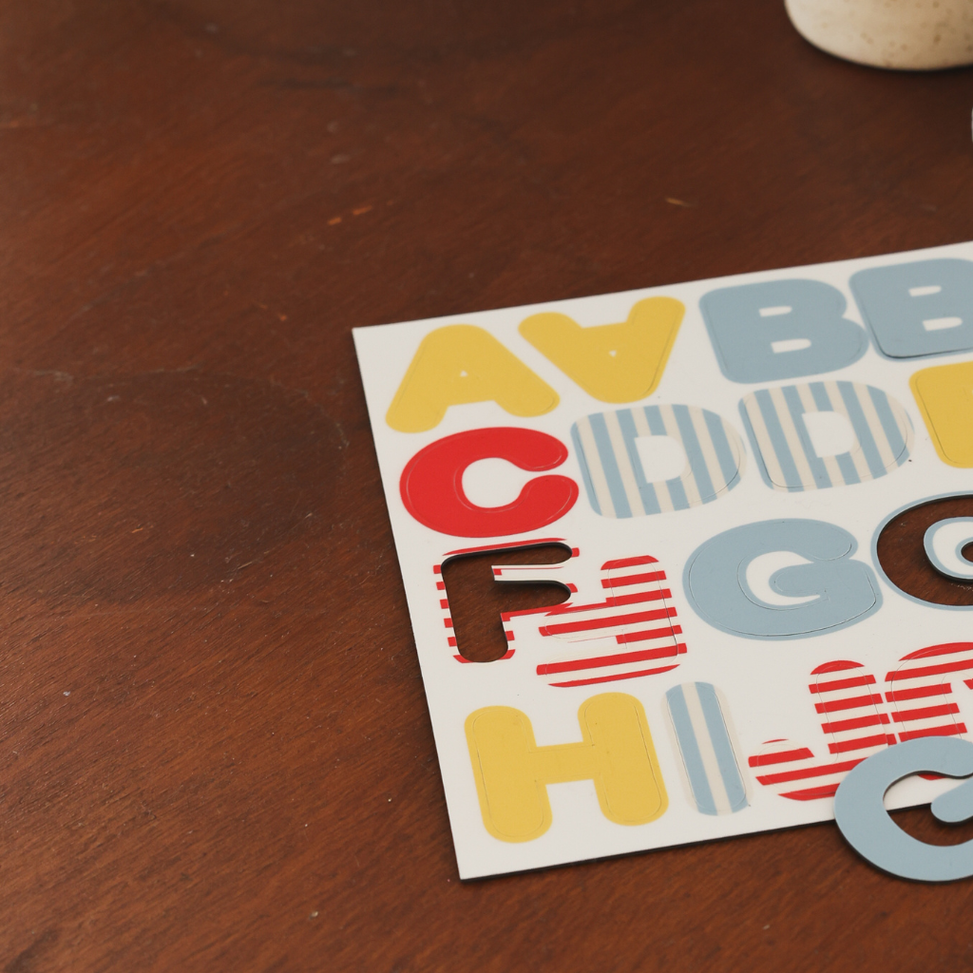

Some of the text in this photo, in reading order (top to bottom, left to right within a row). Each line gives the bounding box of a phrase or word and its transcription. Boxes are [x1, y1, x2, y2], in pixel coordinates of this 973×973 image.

[385, 323, 561, 435] A
[698, 277, 872, 385] B
[398, 425, 580, 538] C
[569, 402, 747, 520] D
[737, 380, 915, 493] D
[682, 518, 885, 642] G
[462, 690, 670, 844] H
